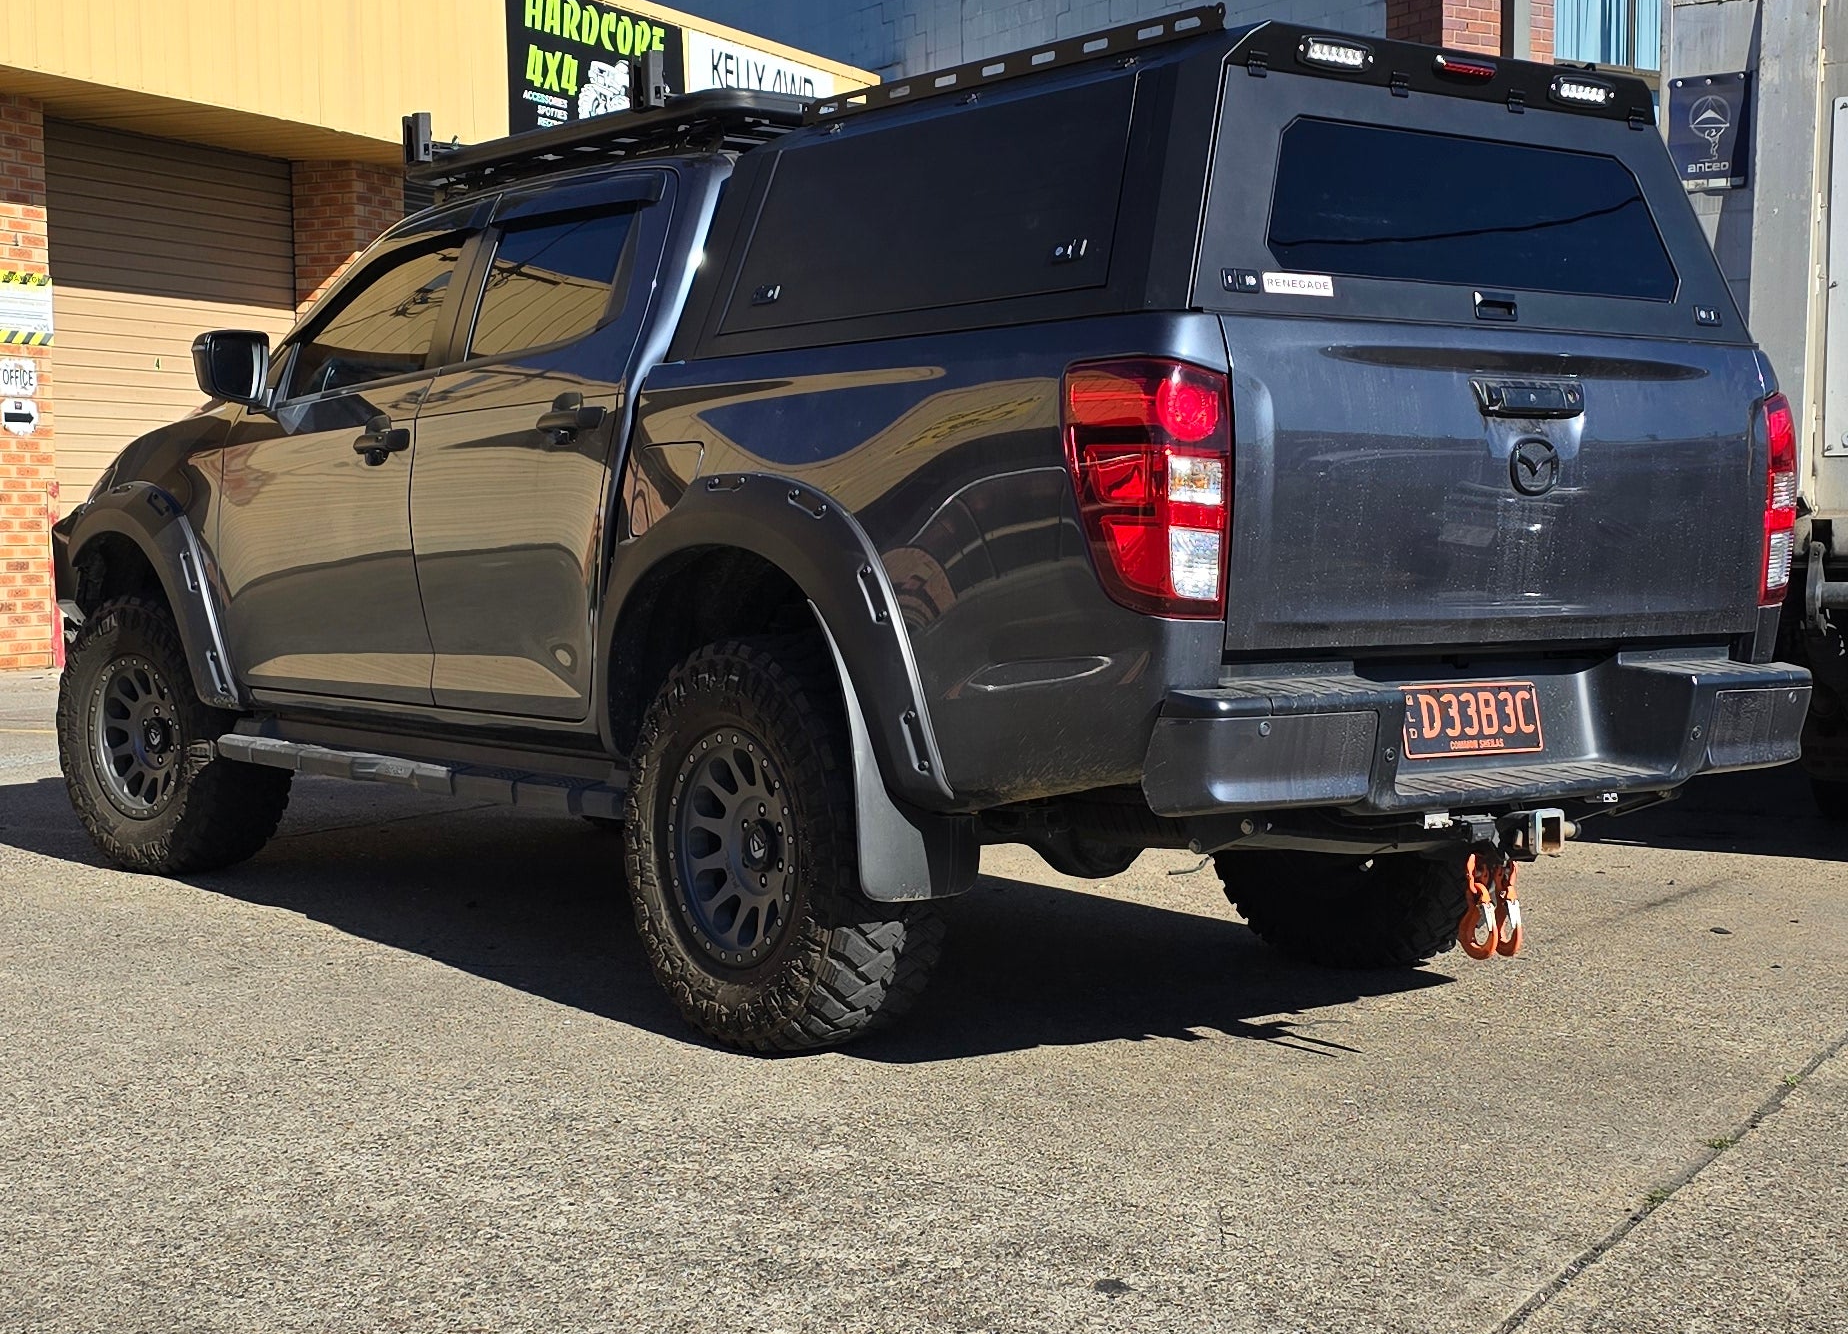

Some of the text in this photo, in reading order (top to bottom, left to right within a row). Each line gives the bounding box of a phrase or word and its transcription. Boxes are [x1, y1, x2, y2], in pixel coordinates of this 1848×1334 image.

[525, 43, 579, 96] 4X4
[1687, 161, 1729, 173] anteo
[1266, 278, 1330, 290] RENEGADE
[2, 368, 34, 387] OFFICE
[1417, 690, 1536, 739] D33B3C
